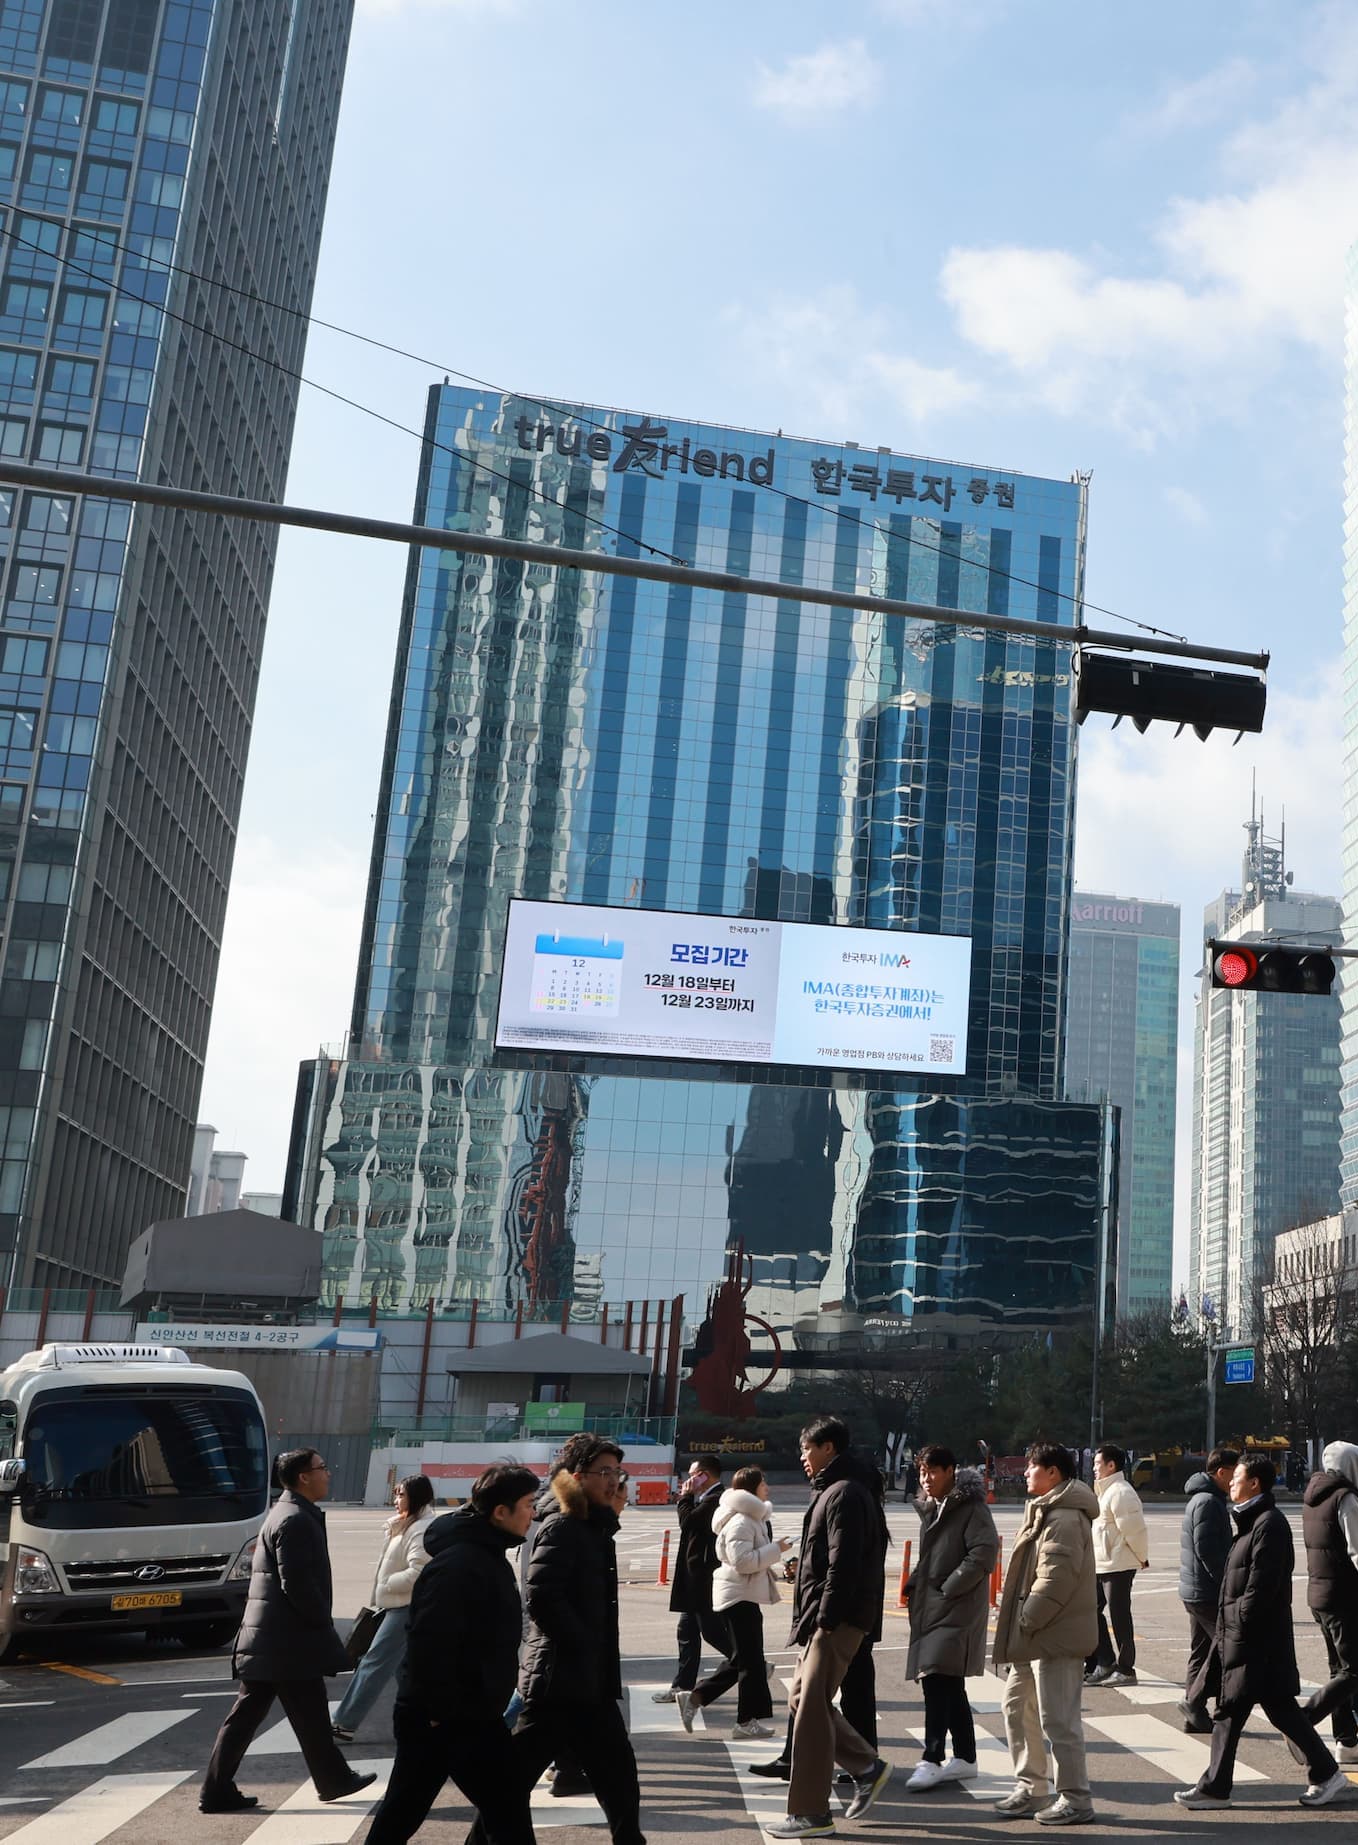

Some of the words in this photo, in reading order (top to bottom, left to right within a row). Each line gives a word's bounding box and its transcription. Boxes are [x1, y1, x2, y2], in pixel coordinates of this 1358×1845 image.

[811, 457, 956, 512] 한국투자
[966, 477, 1015, 509] 증권
[729, 926, 758, 934] 한국투자
[572, 959, 586, 968] 12
[842, 952, 877, 964] 한국투자
[880, 953, 911, 968] IMA
[644, 974, 674, 988] 12월
[678, 976, 735, 992] 18일부터
[803, 980, 945, 1004] IMA(종합투자계좌)는
[661, 994, 692, 1008] 12월
[694, 996, 754, 1012] 23일까지
[814, 998, 932, 1021] 한국투자증권에서!
[817, 1047, 840, 1058] 가까운
[841, 1049, 865, 1059] 영업점
[866, 1050, 885, 1060] PB와
[886, 1052, 925, 1062] 상담하세요
[150, 1328, 198, 1341] 신안산선
[254, 1330, 300, 1343] 4-2공구
[148, 1594, 178, 1606] 6705
